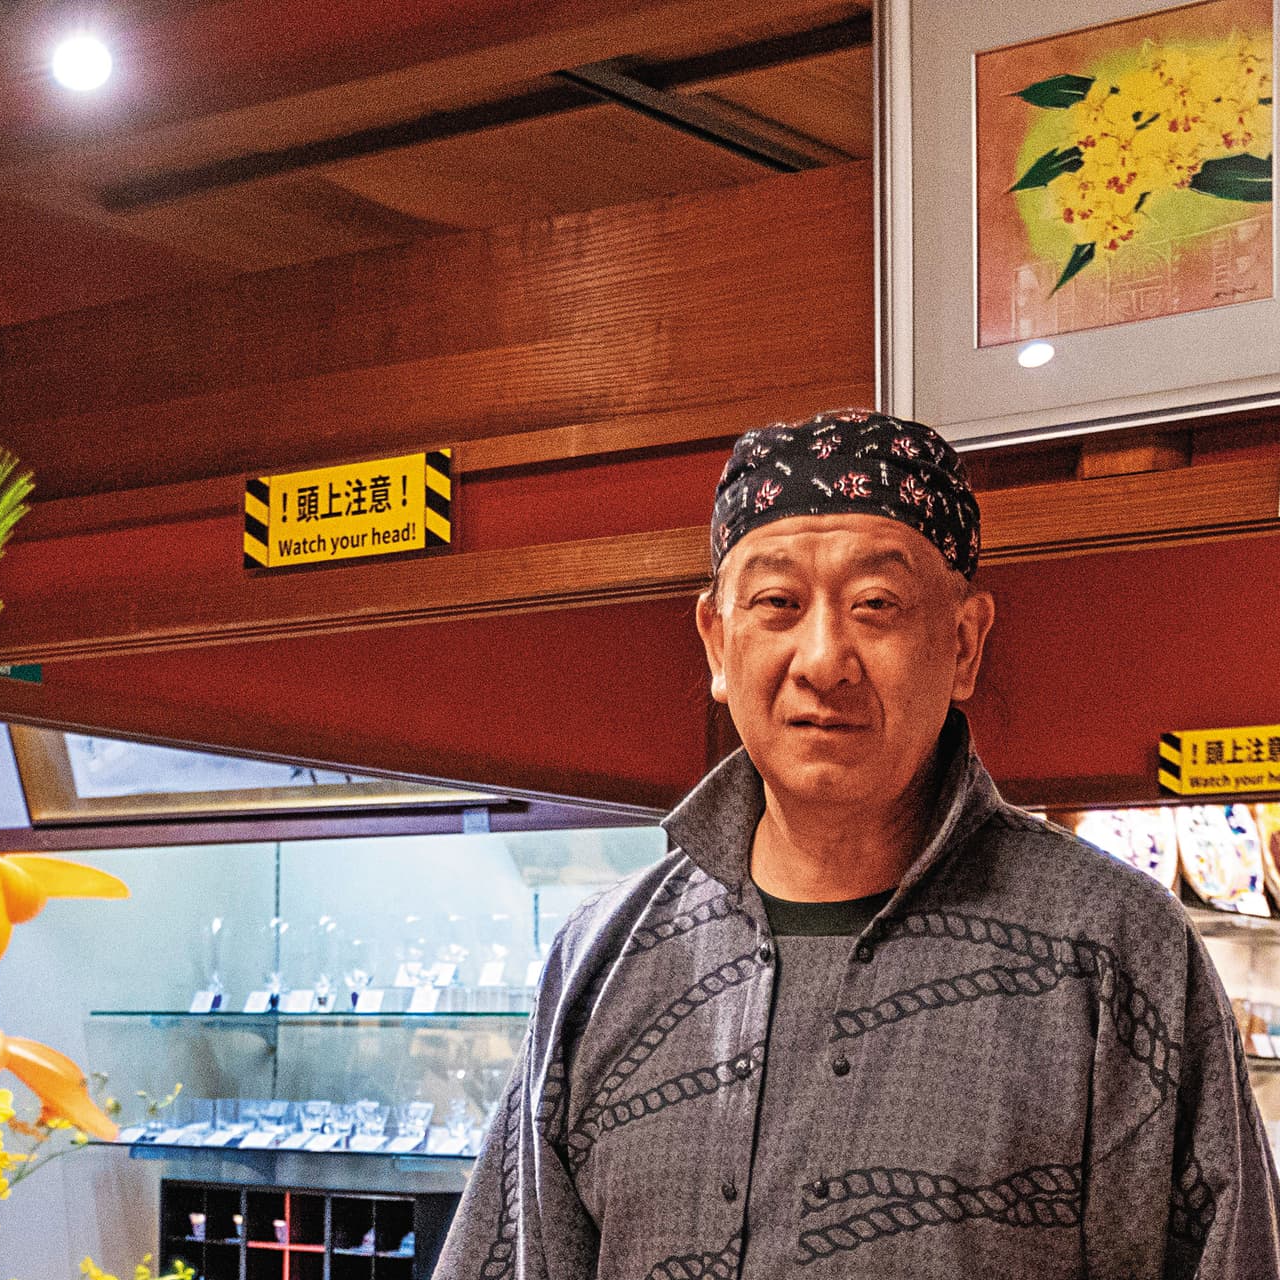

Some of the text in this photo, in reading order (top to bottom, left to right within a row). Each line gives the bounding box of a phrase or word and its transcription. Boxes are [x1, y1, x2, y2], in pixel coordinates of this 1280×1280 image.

[278, 522, 417, 558] Watch your head!
